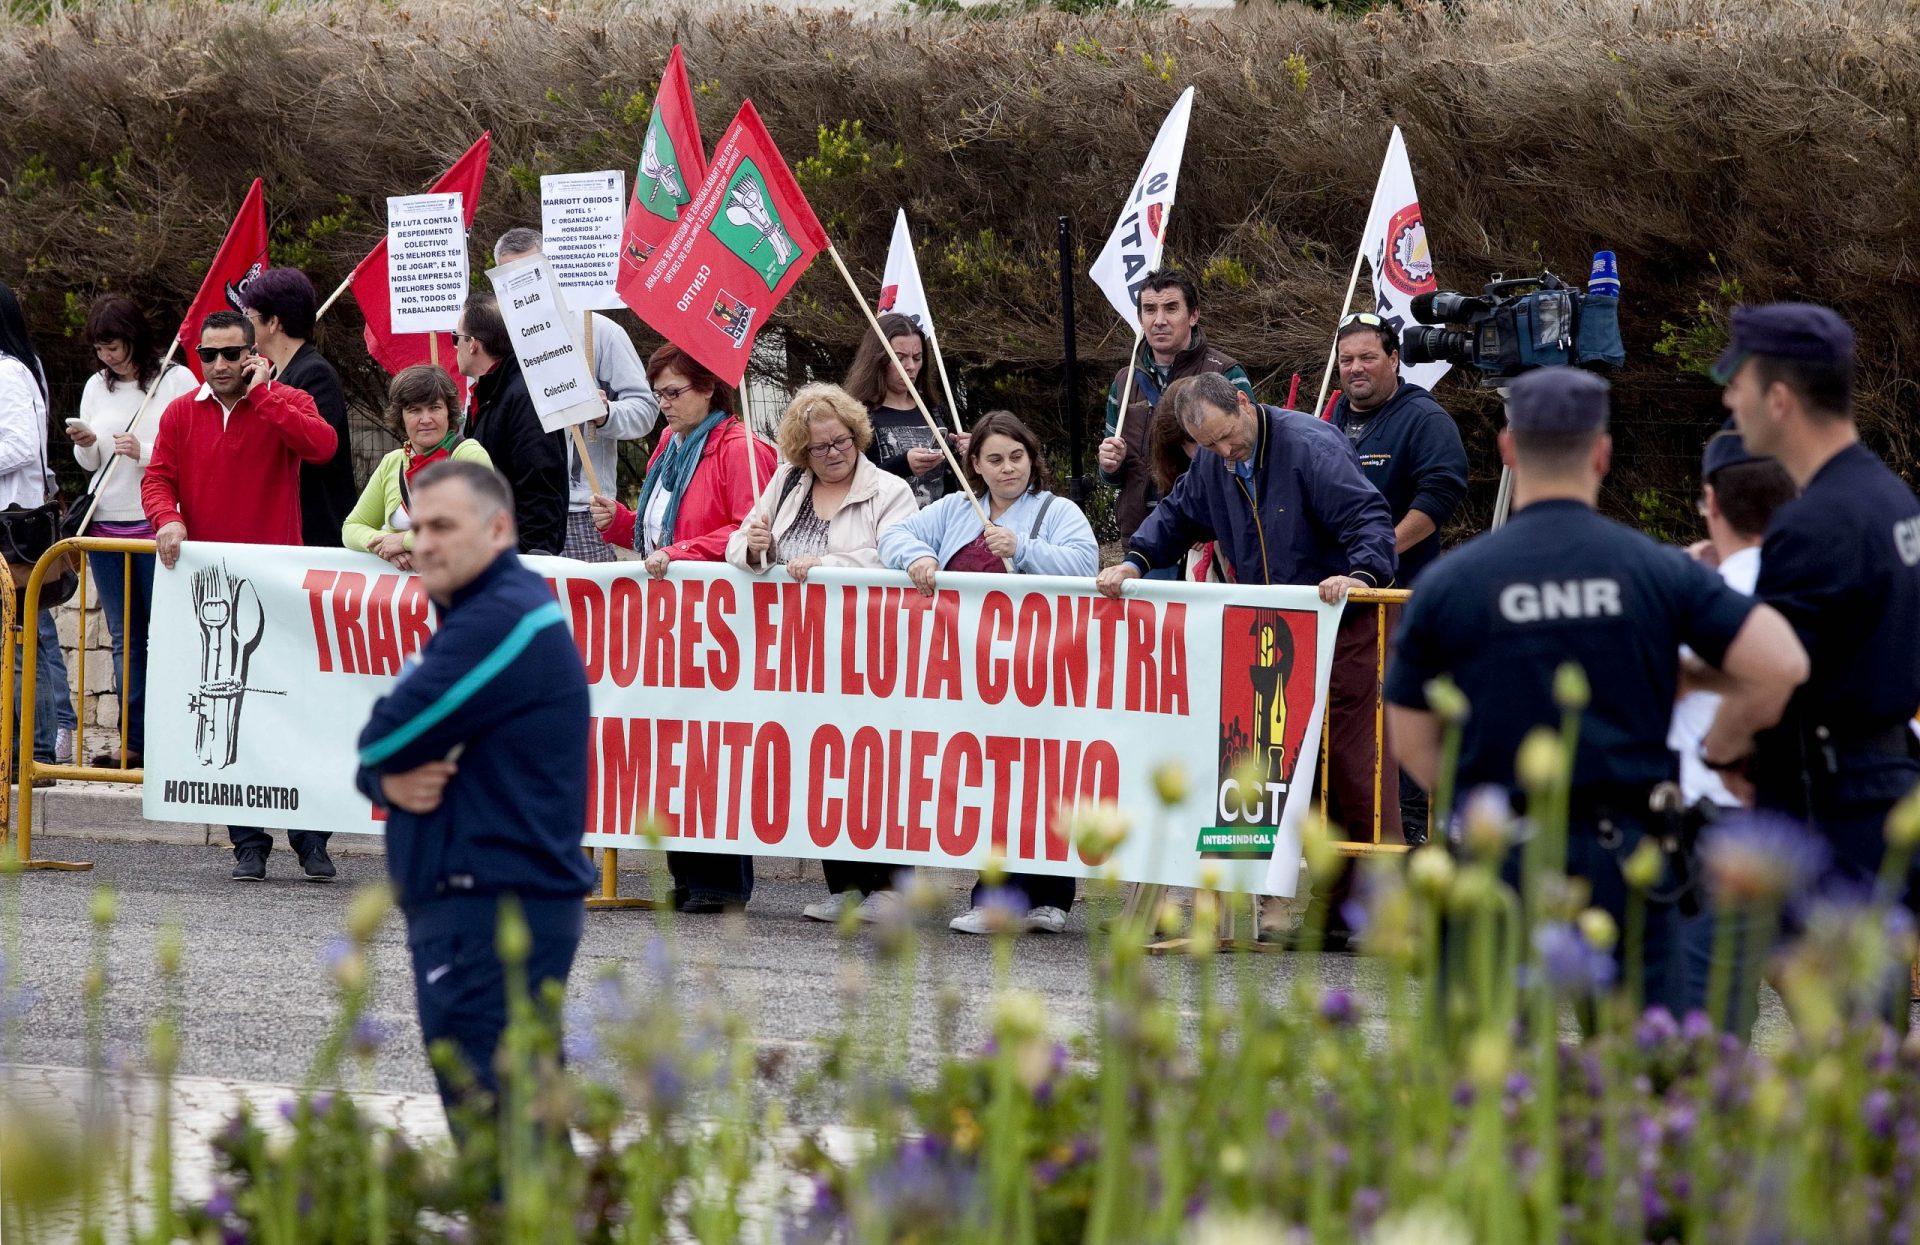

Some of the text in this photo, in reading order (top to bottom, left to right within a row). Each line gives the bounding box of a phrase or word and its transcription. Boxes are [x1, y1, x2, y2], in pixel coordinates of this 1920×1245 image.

[391, 220, 401, 228] EM
[423, 217, 452, 225] CONTRA
[398, 228, 452, 238] DESPEDIMENTO
[404, 240, 448, 248] COLECTIVO!
[406, 250, 446, 259] MELHORES
[395, 284, 434, 293] MELHORES
[420, 294, 446, 302] TODOS
[514, 293, 540, 309] Em Luta
[397, 304, 460, 315] TRABALHADORES!
[521, 323, 545, 337] Contra
[523, 344, 573, 368] Despedimento
[544, 379, 577, 397] Colectivo!
[1499, 578, 1623, 624] GNR
[302, 568, 1190, 716] TRABDORES EM LUTA CONTRA
[163, 779, 299, 811] HOTELARIA CENTRO
[807, 723, 1120, 867] COLECTIVO
[1202, 834, 1271, 846] INTERSINDICAL
